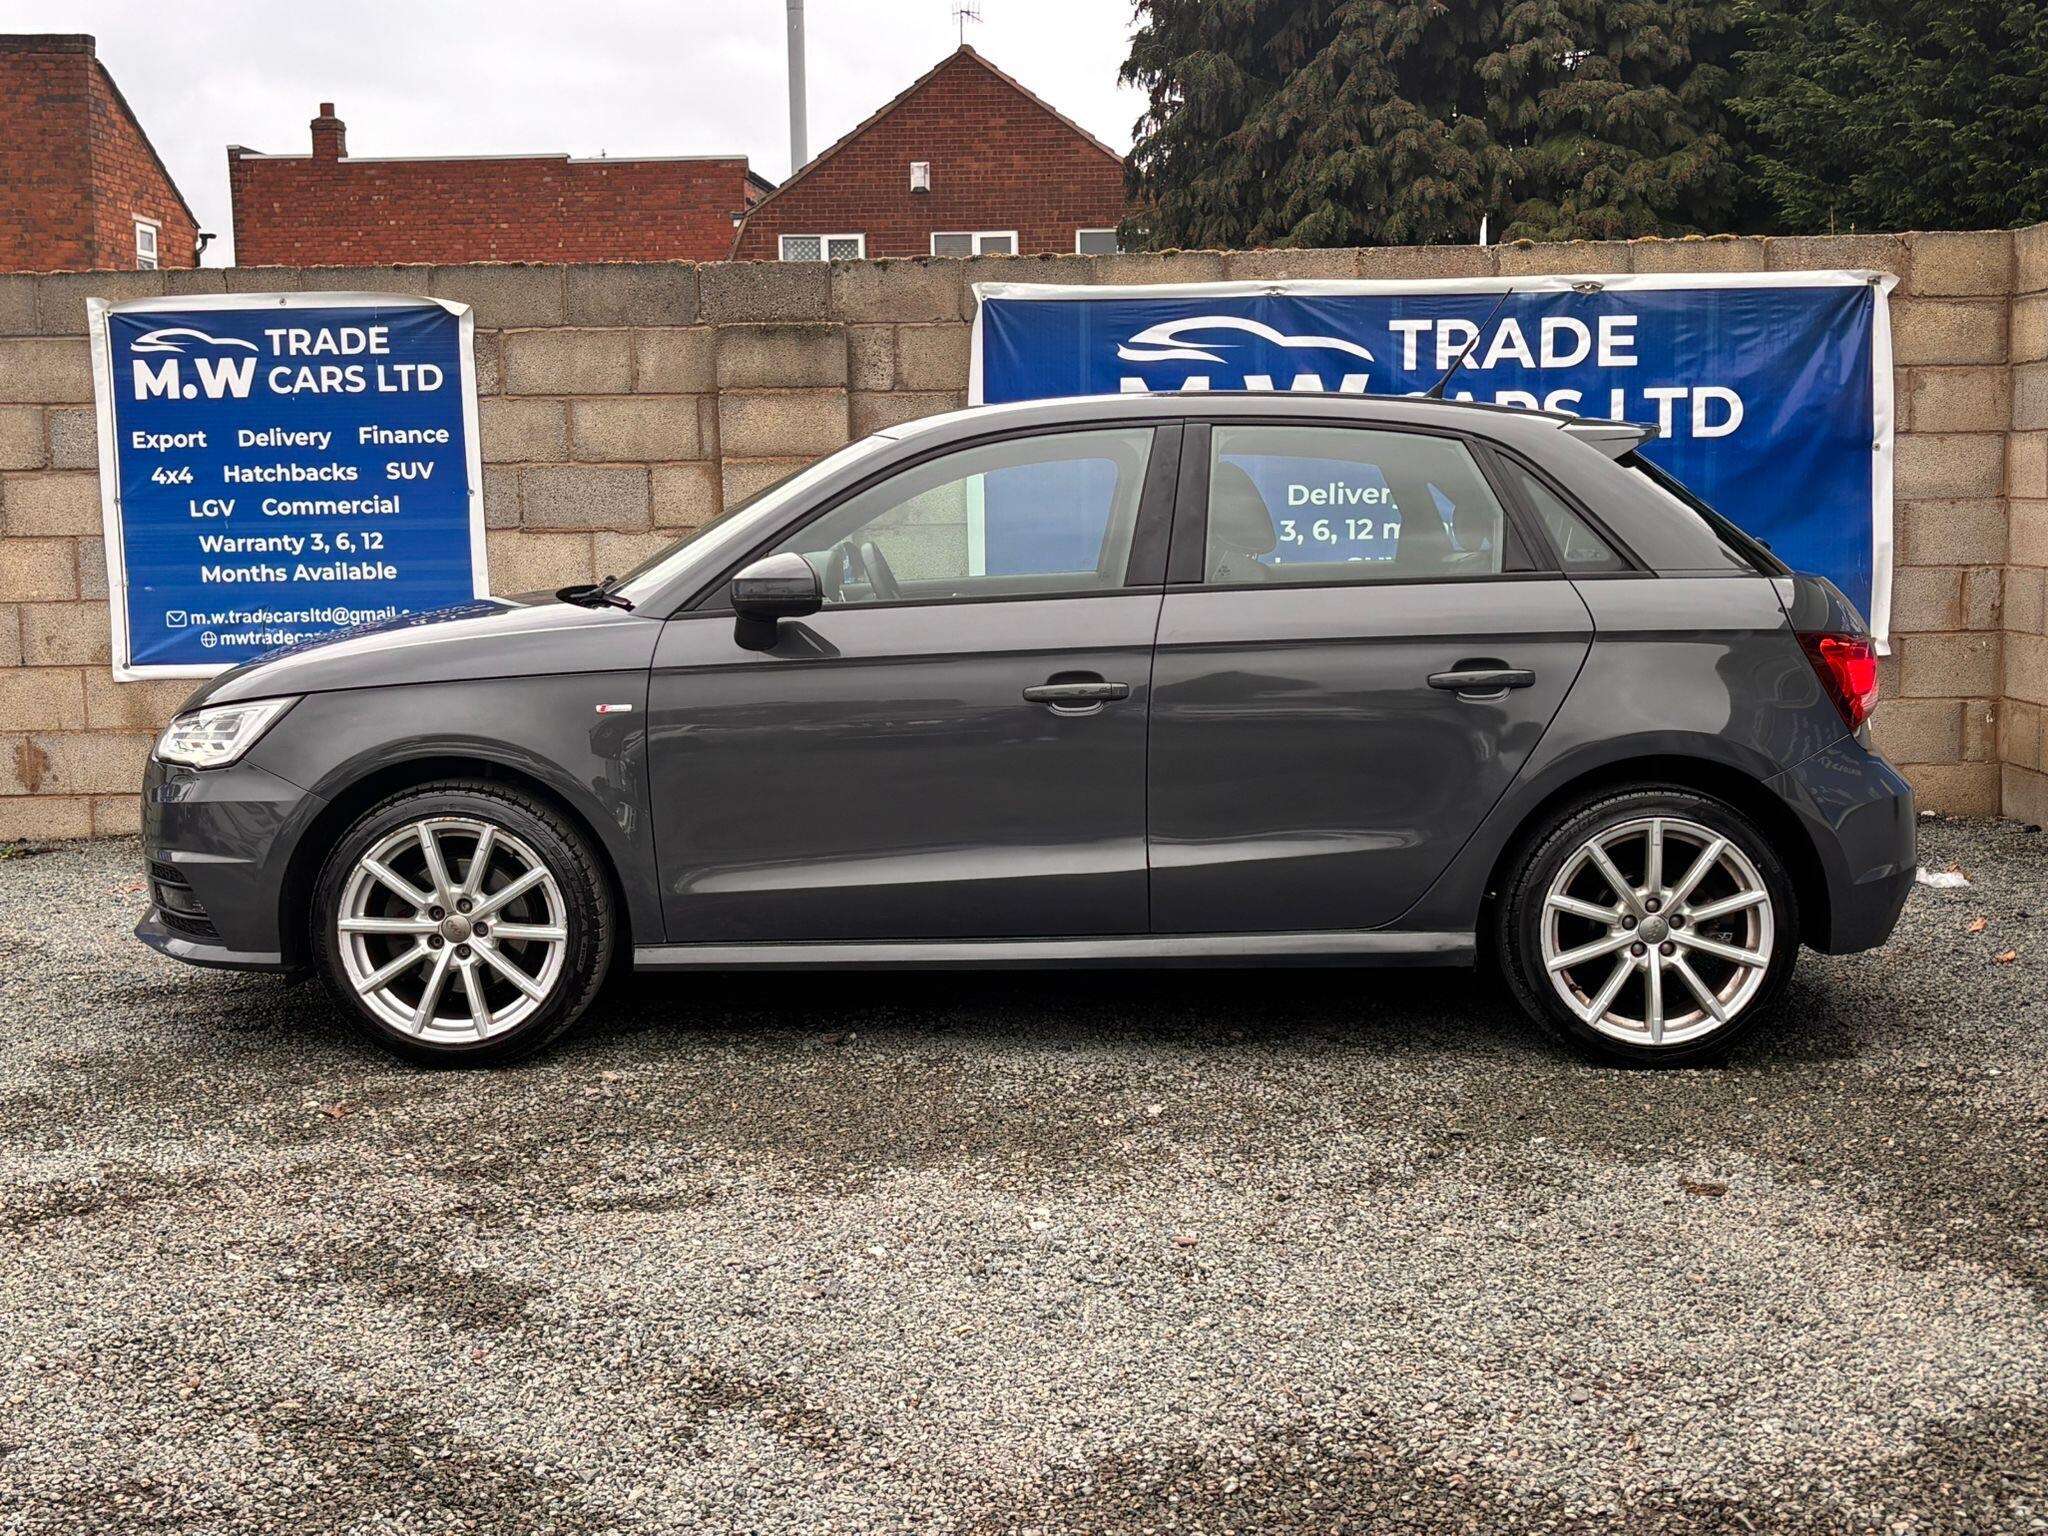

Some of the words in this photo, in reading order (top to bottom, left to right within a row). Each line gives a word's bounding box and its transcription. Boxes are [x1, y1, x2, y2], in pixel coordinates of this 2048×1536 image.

[265, 327, 390, 355] TRADE
[1389, 315, 1638, 370] TRADE
[133, 358, 257, 400] M.W
[268, 365, 366, 394] CARS
[378, 364, 443, 392] LTD
[132, 430, 207, 452] Export
[238, 428, 331, 449] Delivery
[359, 425, 449, 444] Finance
[152, 467, 193, 484] 4x4
[223, 463, 358, 482] Hatchbacks
[386, 461, 434, 480] SUV
[189, 499, 235, 518] LGV
[262, 495, 400, 516] Commercial
[1288, 482, 1398, 510] Deliver
[199, 534, 305, 555] Warranty
[311, 533, 330, 554] 3,
[336, 532, 356, 553] 6,
[361, 532, 384, 550] 12
[1280, 520, 1304, 545] 3,
[1312, 519, 1337, 544] 6,
[1345, 518, 1373, 540] 12
[201, 563, 287, 583] Months
[293, 562, 397, 582] Available
